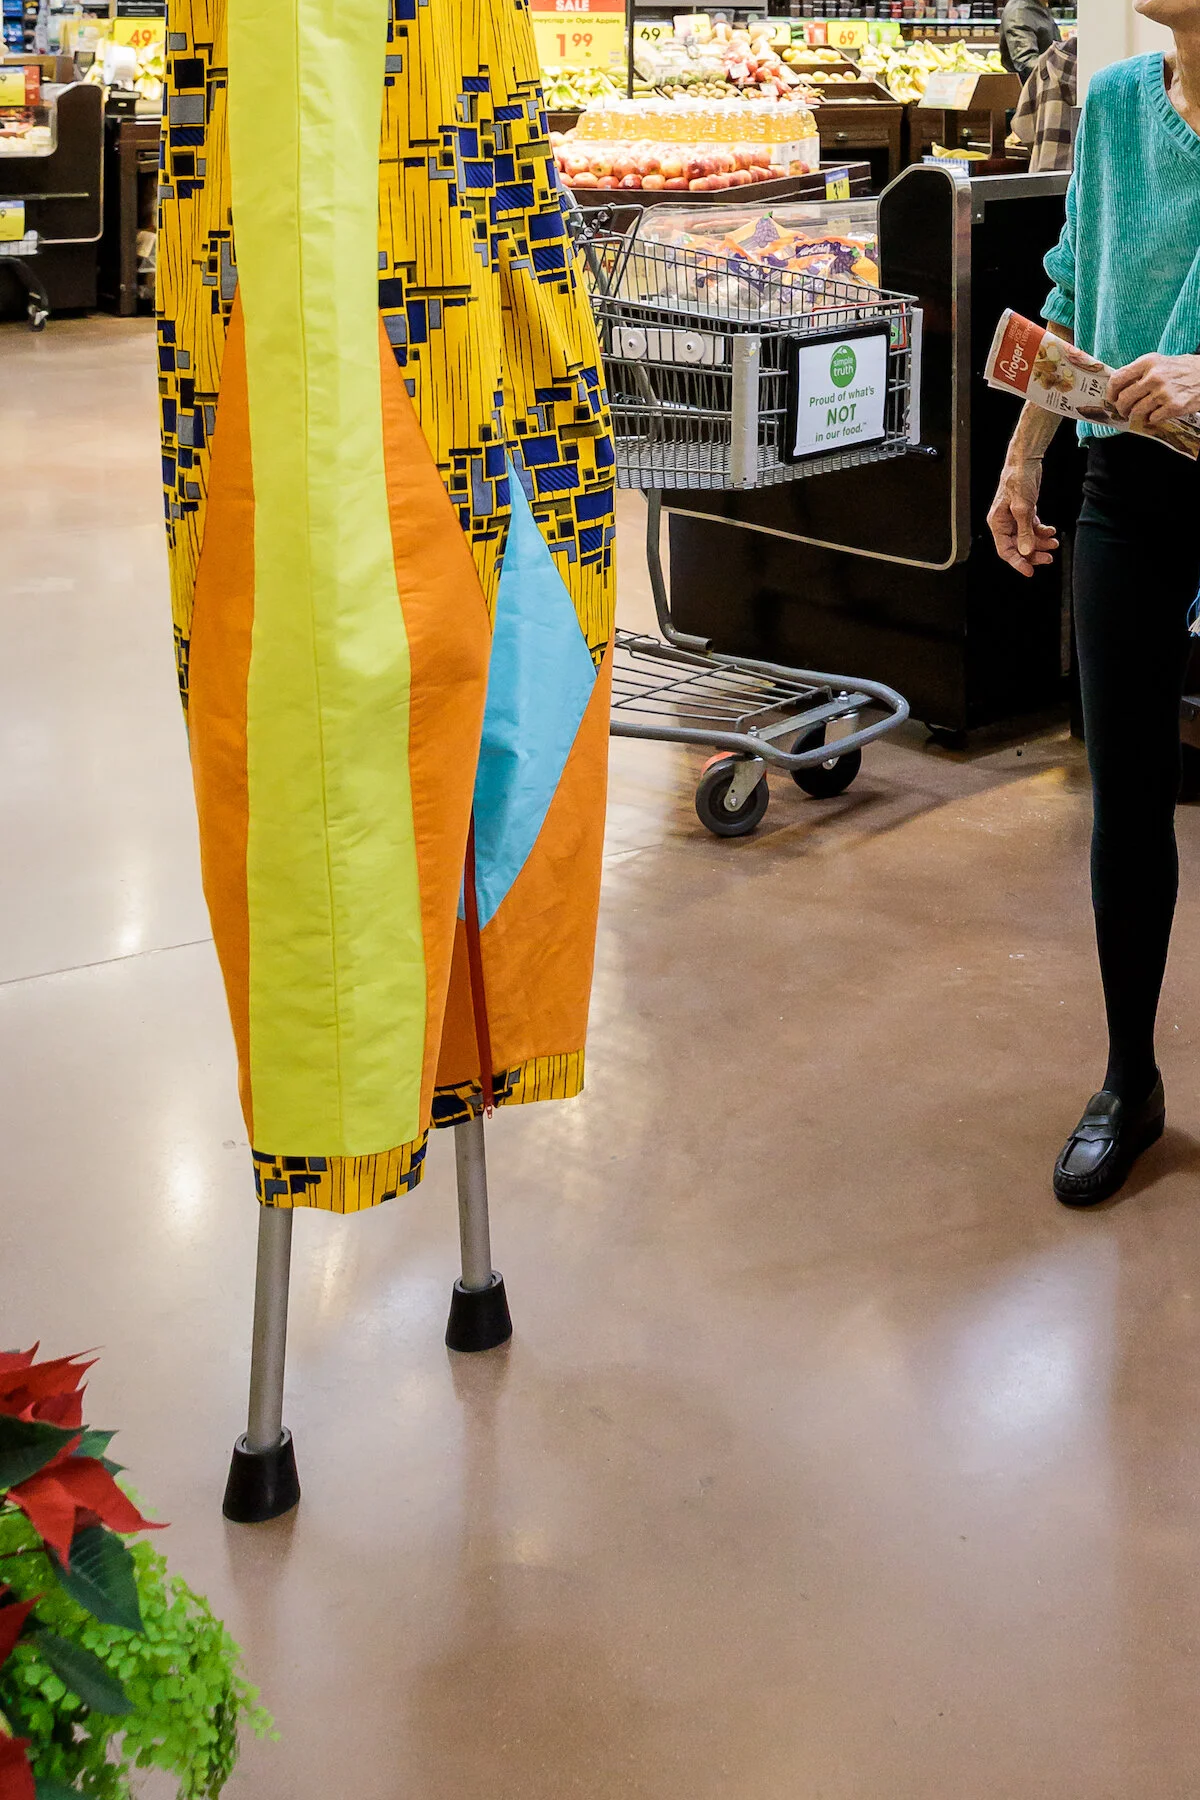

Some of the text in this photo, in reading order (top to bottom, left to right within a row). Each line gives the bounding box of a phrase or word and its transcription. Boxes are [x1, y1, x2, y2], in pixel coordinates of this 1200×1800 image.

[555, 0, 590, 12] SALE
[833, 357, 853, 368] simple
[999, 342, 1029, 381] Kroger
[833, 365, 854, 377] truth
[809, 385, 875, 407] Proud of what's
[826, 403, 857, 427] NOT
[815, 432, 823, 442] in
[826, 429, 841, 440] our
